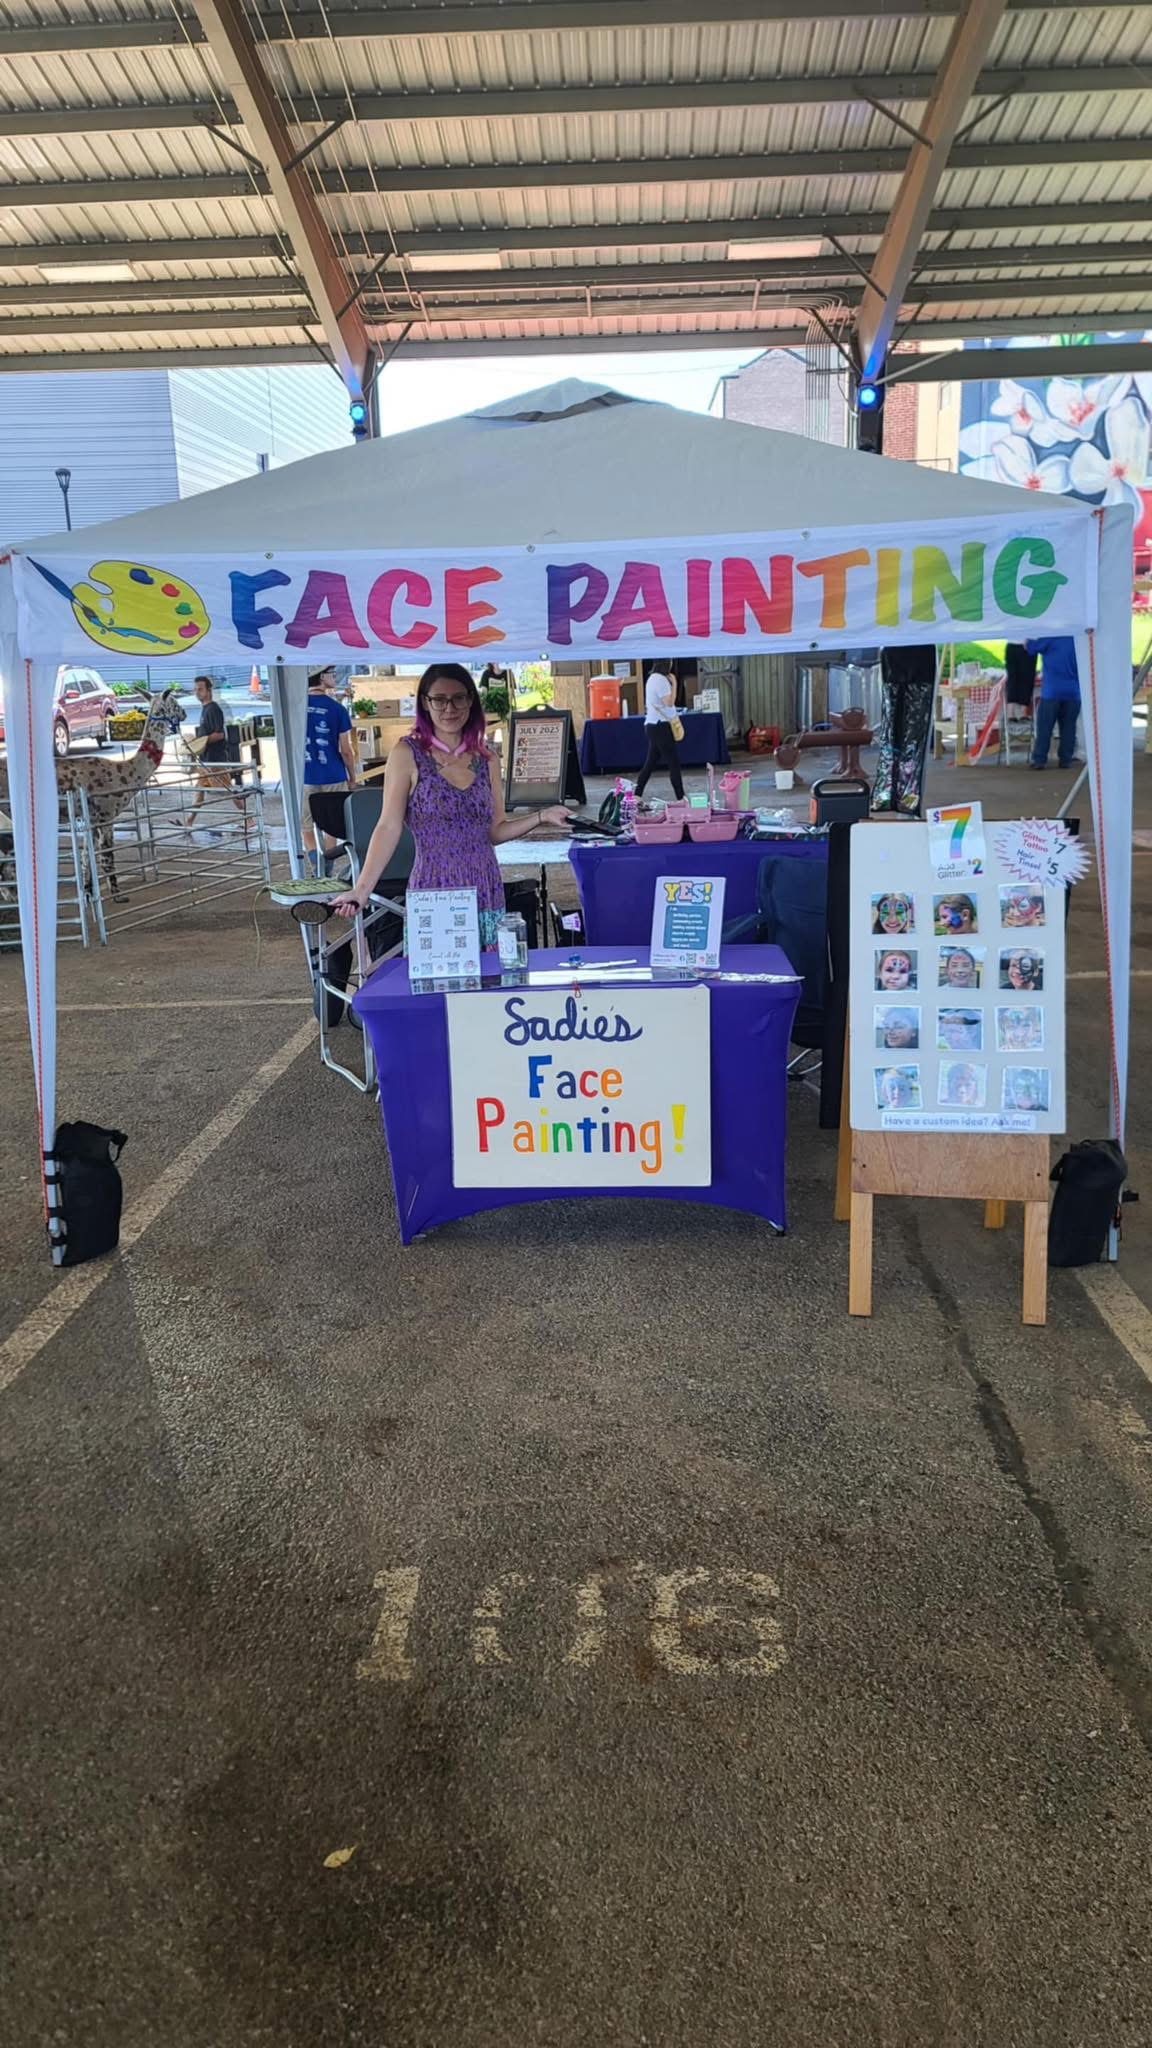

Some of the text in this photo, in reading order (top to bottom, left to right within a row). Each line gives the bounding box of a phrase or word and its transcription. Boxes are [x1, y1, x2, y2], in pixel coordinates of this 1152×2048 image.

[228, 537, 1068, 649] FACE PAINTING
[520, 727, 537, 735] JULY
[1022, 830, 1047, 843] Glitter
[1023, 839, 1049, 852] Tattoo
[1016, 848, 1035, 859] Hair
[1018, 857, 1041, 870] Tinsel
[664, 881, 713, 904] YES!
[504, 996, 643, 1045] Sadie's
[528, 1055, 623, 1099] Face
[884, 1116, 911, 1126] Have
[922, 1116, 960, 1126] custom
[961, 1115, 988, 1126] idea?
[476, 1097, 686, 1174] Painting!
